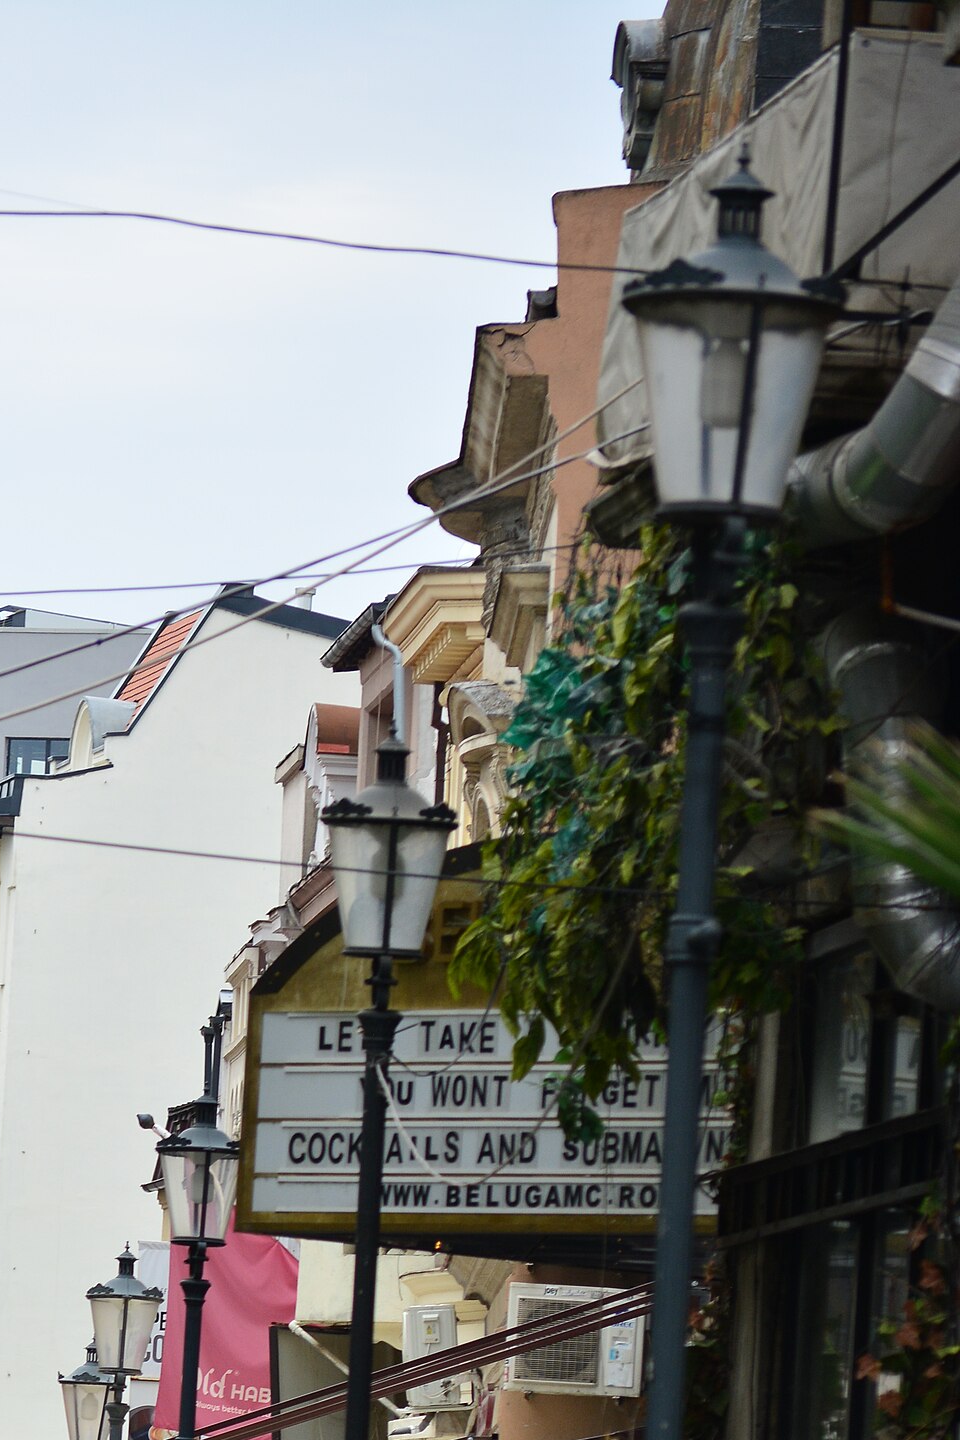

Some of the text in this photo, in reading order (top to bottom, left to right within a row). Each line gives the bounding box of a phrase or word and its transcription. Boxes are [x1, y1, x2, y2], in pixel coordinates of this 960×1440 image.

[421, 1021, 495, 1053] TAKE
[432, 1075, 508, 1107] WONT
[541, 1075, 660, 1108] FGET
[289, 1131, 460, 1164] COCKAILS
[477, 1131, 537, 1165] AND
